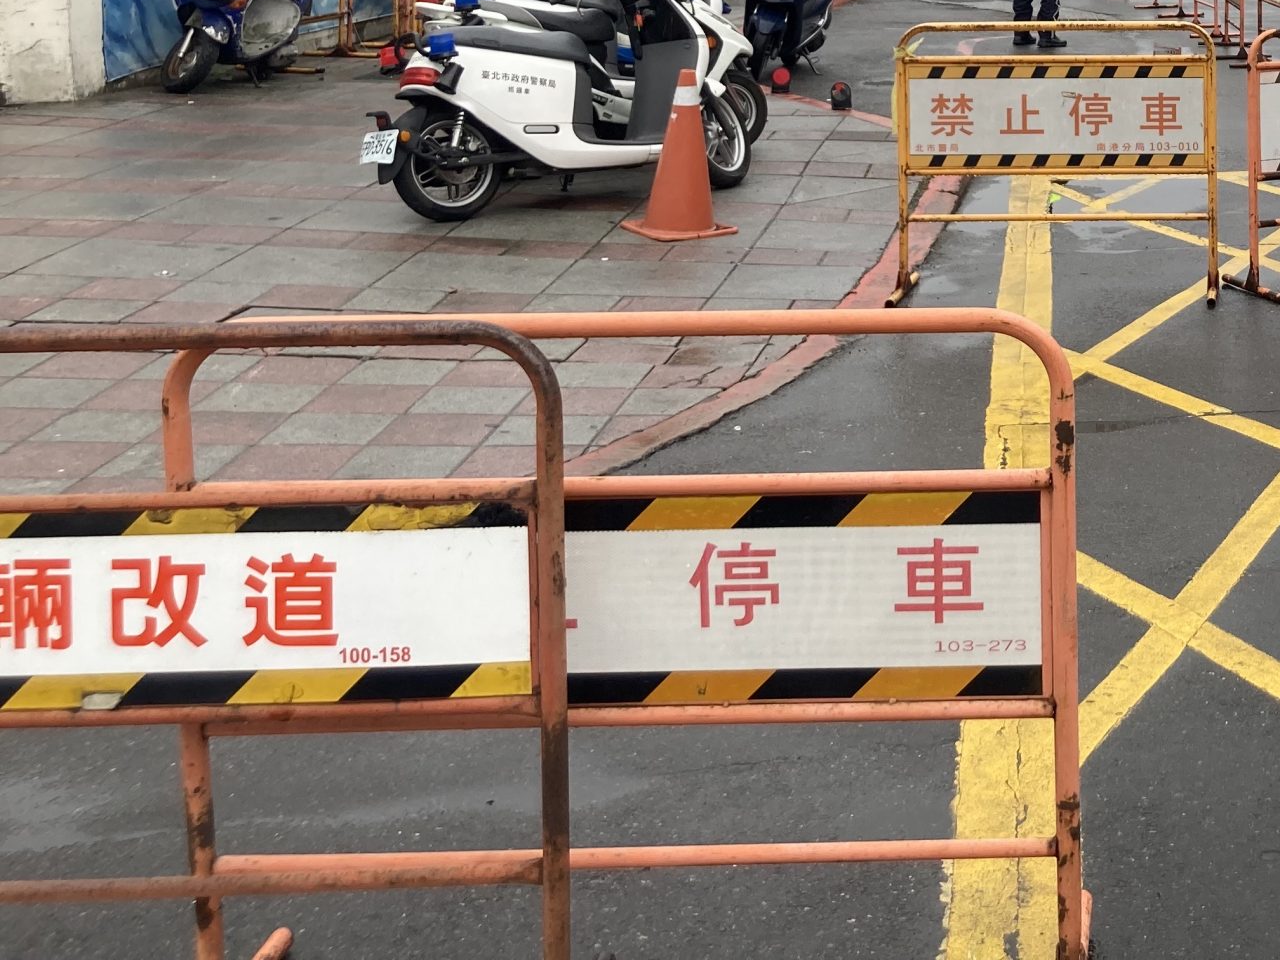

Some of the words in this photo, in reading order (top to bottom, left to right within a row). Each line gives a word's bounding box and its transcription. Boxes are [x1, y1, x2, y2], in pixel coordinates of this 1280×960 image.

[481, 70, 557, 89] 臺北市政府警察局
[930, 92, 1183, 137] 禁止停車
[1149, 141, 1200, 152] 103-010
[566, 538, 984, 628] 停車
[338, 646, 412, 665] 100-158
[934, 639, 1028, 653] 103-273
